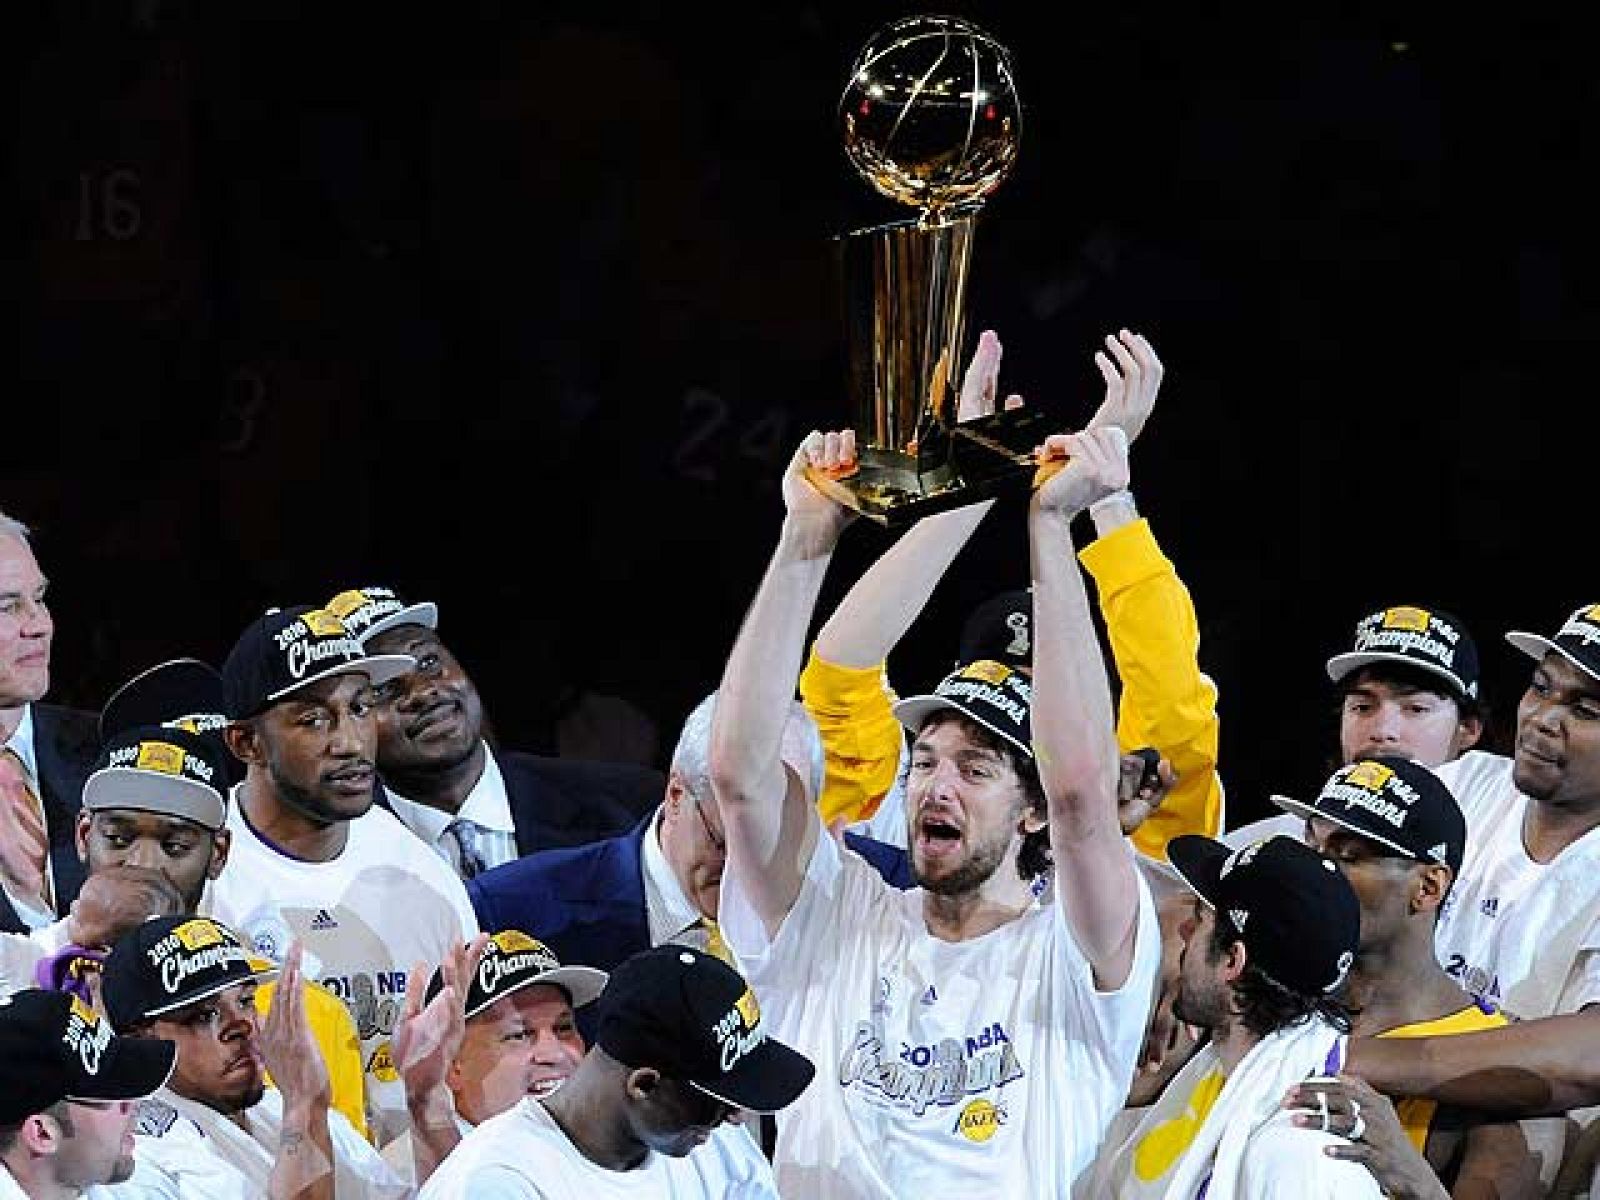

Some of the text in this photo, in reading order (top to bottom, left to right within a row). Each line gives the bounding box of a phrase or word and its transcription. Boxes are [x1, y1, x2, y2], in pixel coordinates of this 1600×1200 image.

[273, 620, 308, 651] 2010
[147, 934, 181, 966] 2010
[376, 971, 407, 995] NB
